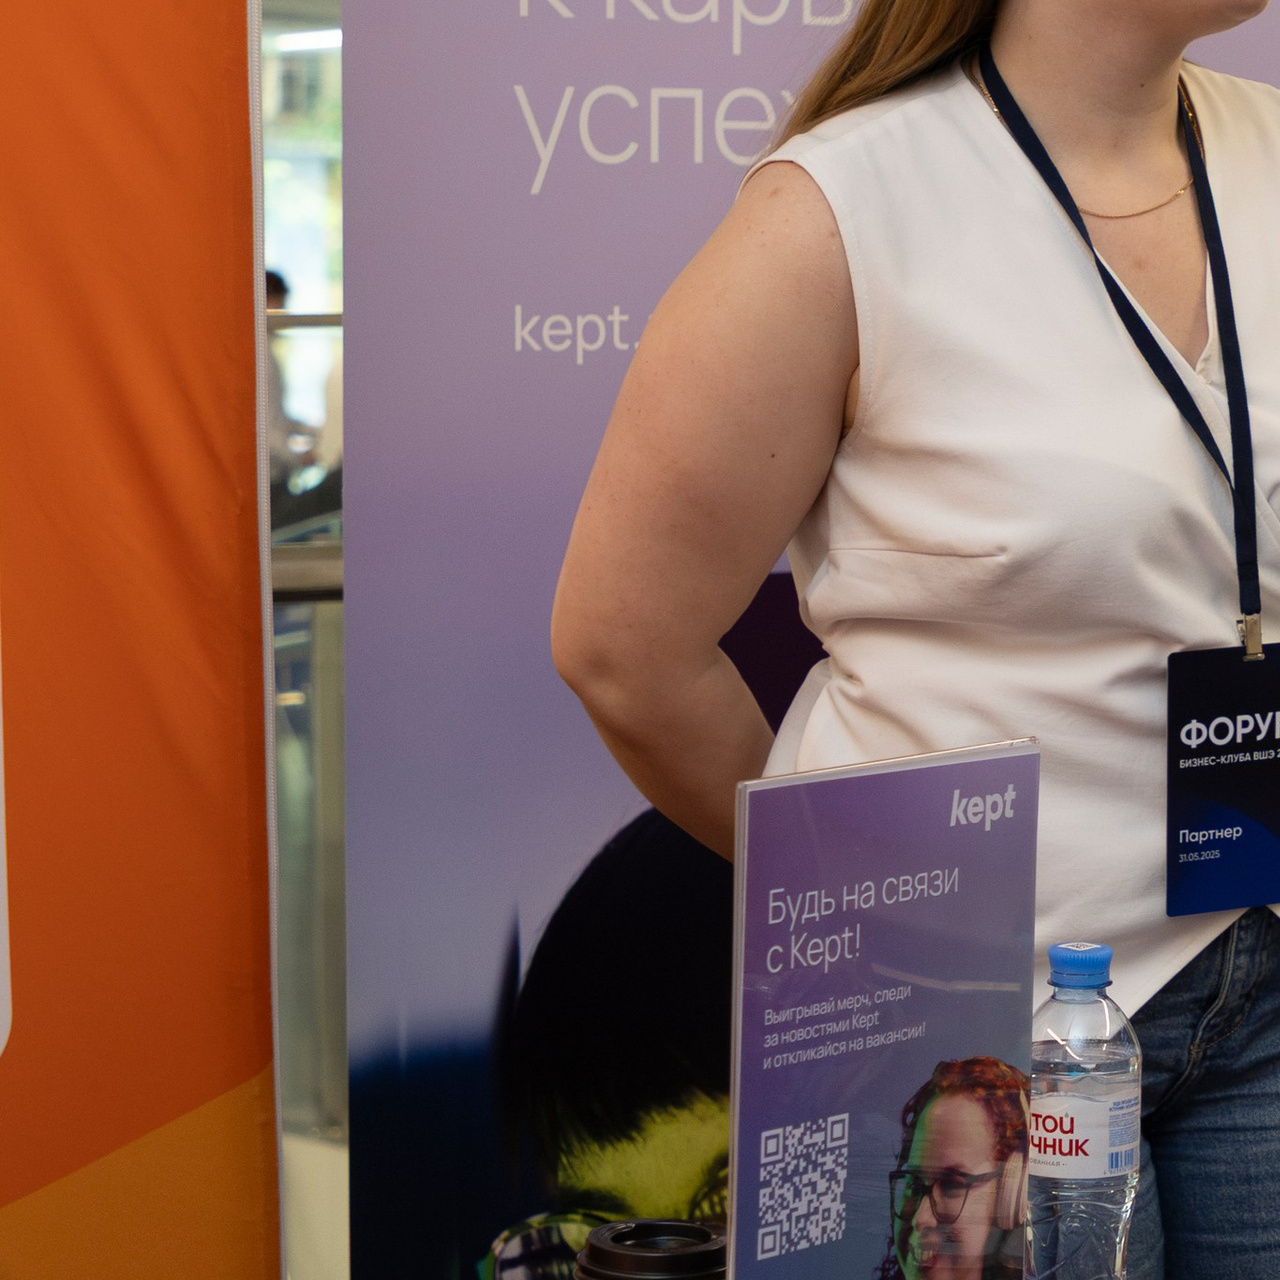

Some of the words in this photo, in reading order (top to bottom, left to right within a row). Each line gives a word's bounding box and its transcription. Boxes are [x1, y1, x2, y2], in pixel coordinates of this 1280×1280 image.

[513, 84, 797, 195] успе
[1179, 752, 1251, 769] БИЗНЕС-КЛУБА
[1253, 748, 1275, 761] ВШЭ
[950, 783, 1016, 831] kept
[1178, 849, 1221, 863] 31.05.2025
[1179, 826, 1243, 845] Партнер
[768, 887, 836, 931] Будь
[842, 880, 875, 912] на
[882, 867, 959, 905] связи
[766, 944, 783, 973] с
[790, 923, 861, 973] Kept!
[764, 996, 836, 1026] Выигрывай
[837, 994, 871, 1012] мерч,
[874, 985, 912, 1004] следи
[763, 1032, 779, 1048] за
[780, 1018, 850, 1044] новостями
[852, 1010, 880, 1032] Kept
[763, 1056, 772, 1070] и
[773, 1041, 847, 1068] откликайся
[848, 1038, 864, 1052] на
[865, 1021, 926, 1049] вакансии!
[1030, 1135, 1090, 1157] ЧНИК
